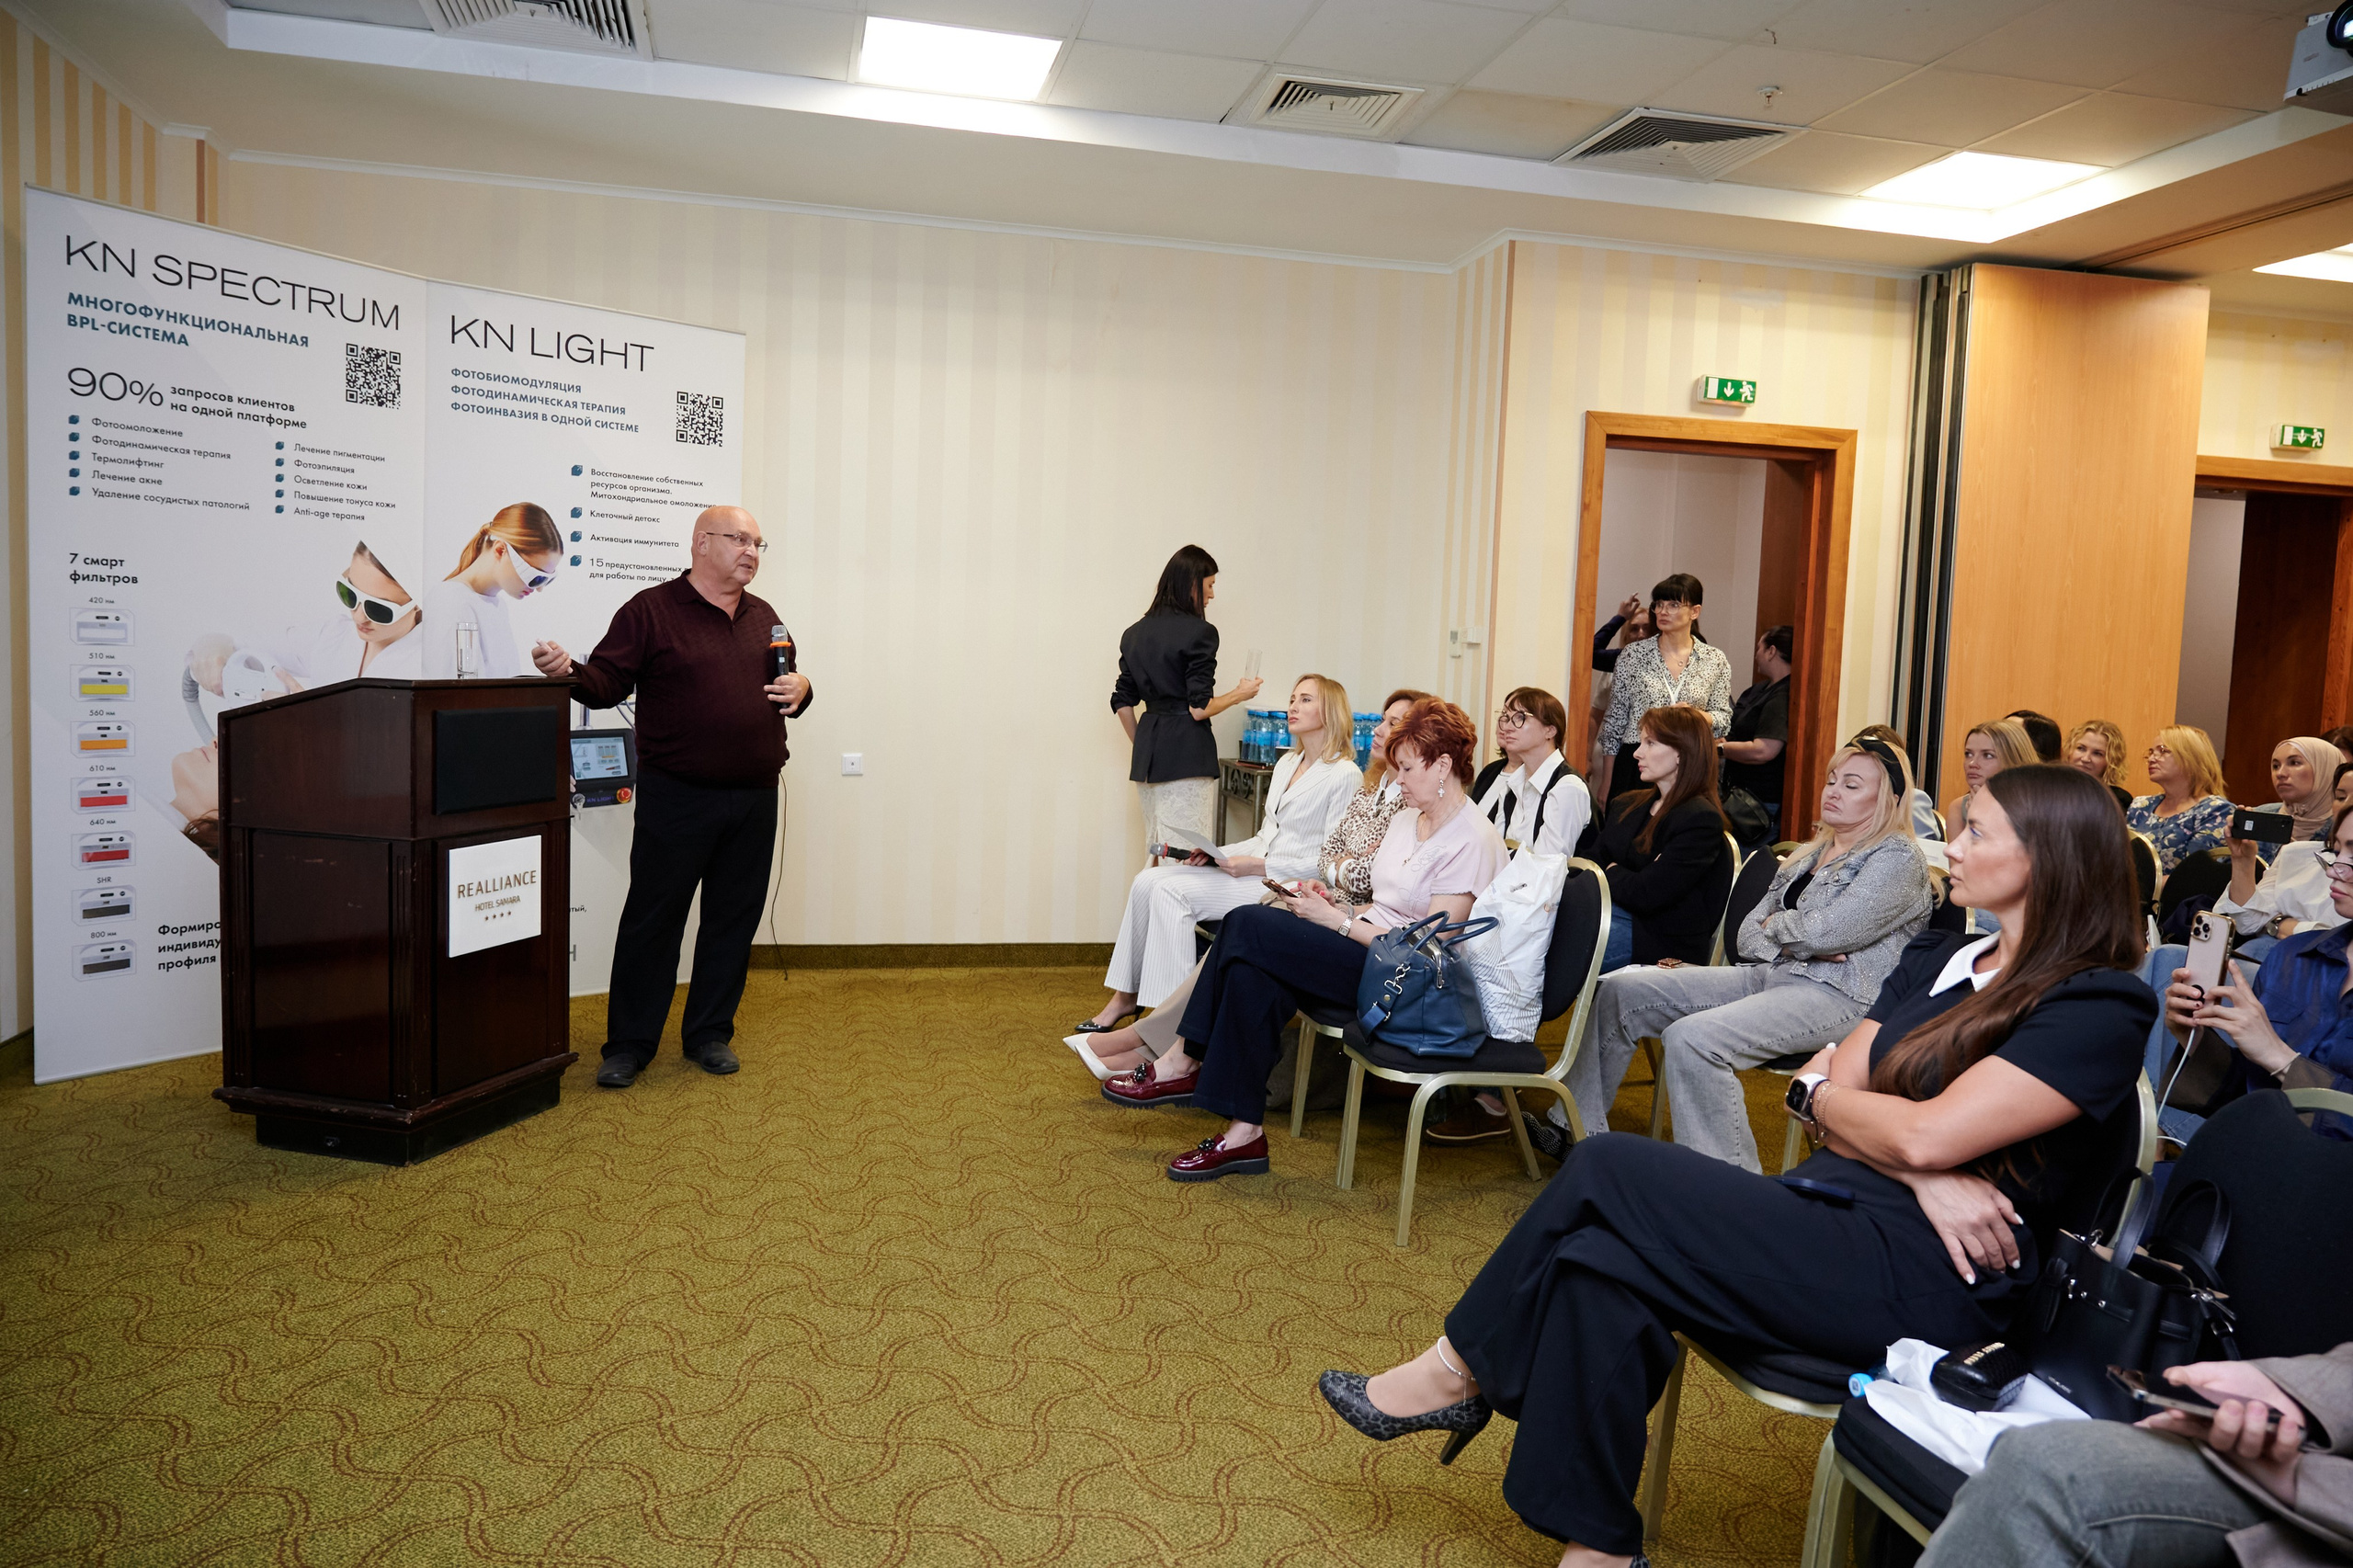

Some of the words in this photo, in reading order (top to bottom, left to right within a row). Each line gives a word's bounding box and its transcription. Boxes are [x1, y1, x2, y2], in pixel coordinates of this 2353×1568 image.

[67, 235, 135, 278] KN
[153, 255, 398, 330] SPECTRUM
[68, 292, 308, 347] МНОГОФУНКЦИОНАЛЬНАЯ
[68, 314, 188, 346] BPL-СИСТЕМА
[451, 315, 513, 352] KN
[531, 328, 654, 371] LIGHT
[68, 368, 164, 406] 90%
[451, 369, 581, 392] ФОТОБИОМОДУЛЯЦИЯ
[171, 387, 233, 403] запросов
[238, 397, 294, 412] клиентов
[451, 385, 577, 409] ФОТОДИНАМИЧЕСКАЯ
[581, 402, 625, 415] ТЕРАПИЯ
[171, 403, 187, 412] на
[192, 406, 233, 417] одной
[237, 413, 306, 428] платформе
[451, 403, 538, 420] ФОТОИНВАЗИЯ
[551, 415, 591, 426] ОДНОЙ
[595, 420, 638, 432] СИСТЕМЕ
[92, 418, 183, 437] Фотоомоложение
[92, 436, 190, 454] Фотодинамическая
[193, 450, 231, 459] терапия
[294, 443, 330, 455] Лечение
[334, 451, 385, 461] пигментации
[92, 452, 164, 468] Термолифтинг
[294, 460, 354, 473] Фотоэпиляция
[92, 471, 135, 483] Лечение
[294, 475, 344, 488] Осветление
[591, 469, 654, 482] Восстановление
[656, 476, 703, 486] собственных
[591, 482, 627, 494] ресурсов
[630, 485, 672, 494] организма.
[92, 488, 141, 500] Удаление
[143, 495, 199, 506] сосудистых
[202, 501, 249, 510] патологий
[294, 491, 342, 503] Повышение
[346, 498, 373, 507] тонуса
[591, 491, 667, 505] Митохондриальное
[294, 507, 329, 519] Anti-age
[332, 513, 364, 521] терапия
[590, 510, 633, 521] Клеточный
[590, 534, 631, 543] Активация
[70, 553, 78, 563] 7
[84, 558, 124, 569] смарт
[590, 559, 604, 567] 15
[606, 562, 682, 572] предустановленных
[70, 570, 138, 585] фильтров
[606, 572, 634, 580] работы
[458, 870, 536, 899] REALLIANCE
[475, 901, 494, 911] HOTEL
[496, 895, 520, 907] SAMARA
[158, 956, 215, 971] профиля
